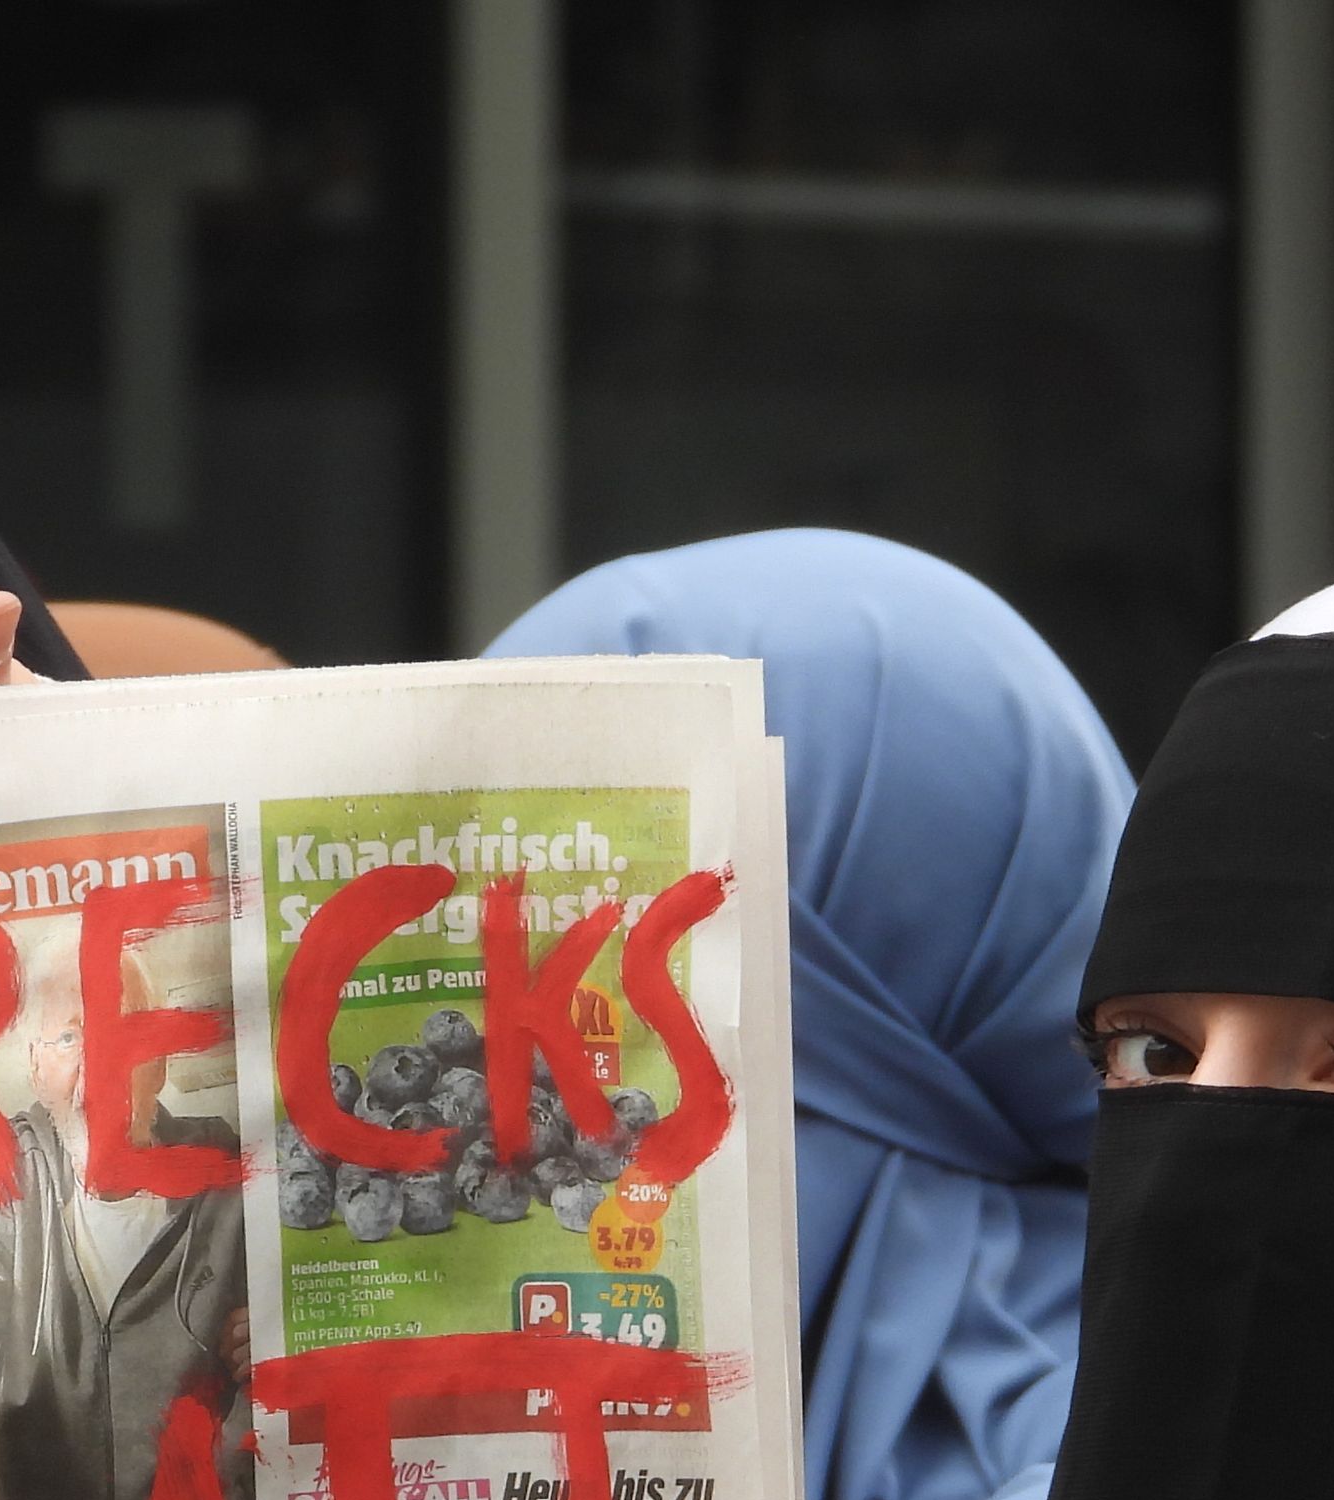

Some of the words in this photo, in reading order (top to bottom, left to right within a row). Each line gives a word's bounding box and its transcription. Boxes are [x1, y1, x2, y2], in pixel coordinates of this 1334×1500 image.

[228, 802, 238, 853] WALLOCHA
[276, 817, 629, 883] Knackfrisch.
[392, 969, 421, 993] zu
[621, 1183, 667, 1202] -20%
[597, 1226, 656, 1251] 3.79
[291, 1258, 379, 1276] Heidelbeeren
[598, 1283, 665, 1308] -27%
[294, 1329, 316, 1342] mit
[319, 1326, 361, 1340] PENNY
[365, 1324, 391, 1338] App
